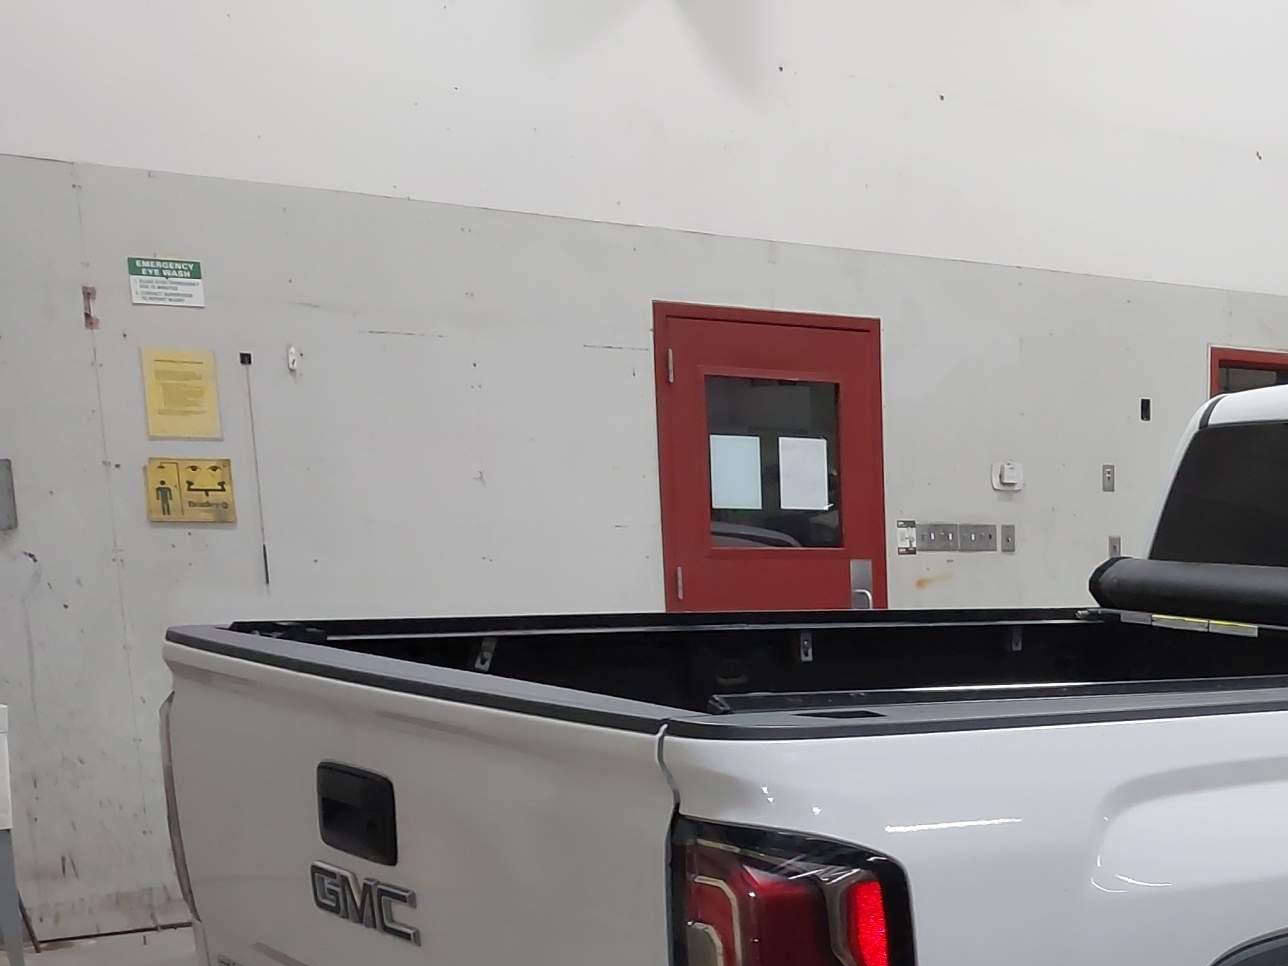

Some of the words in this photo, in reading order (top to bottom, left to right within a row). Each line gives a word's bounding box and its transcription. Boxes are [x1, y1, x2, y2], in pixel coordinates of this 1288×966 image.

[135, 260, 194, 270] EMERGENCY
[162, 269, 191, 277] WASH
[310, 860, 422, 947] GMC
